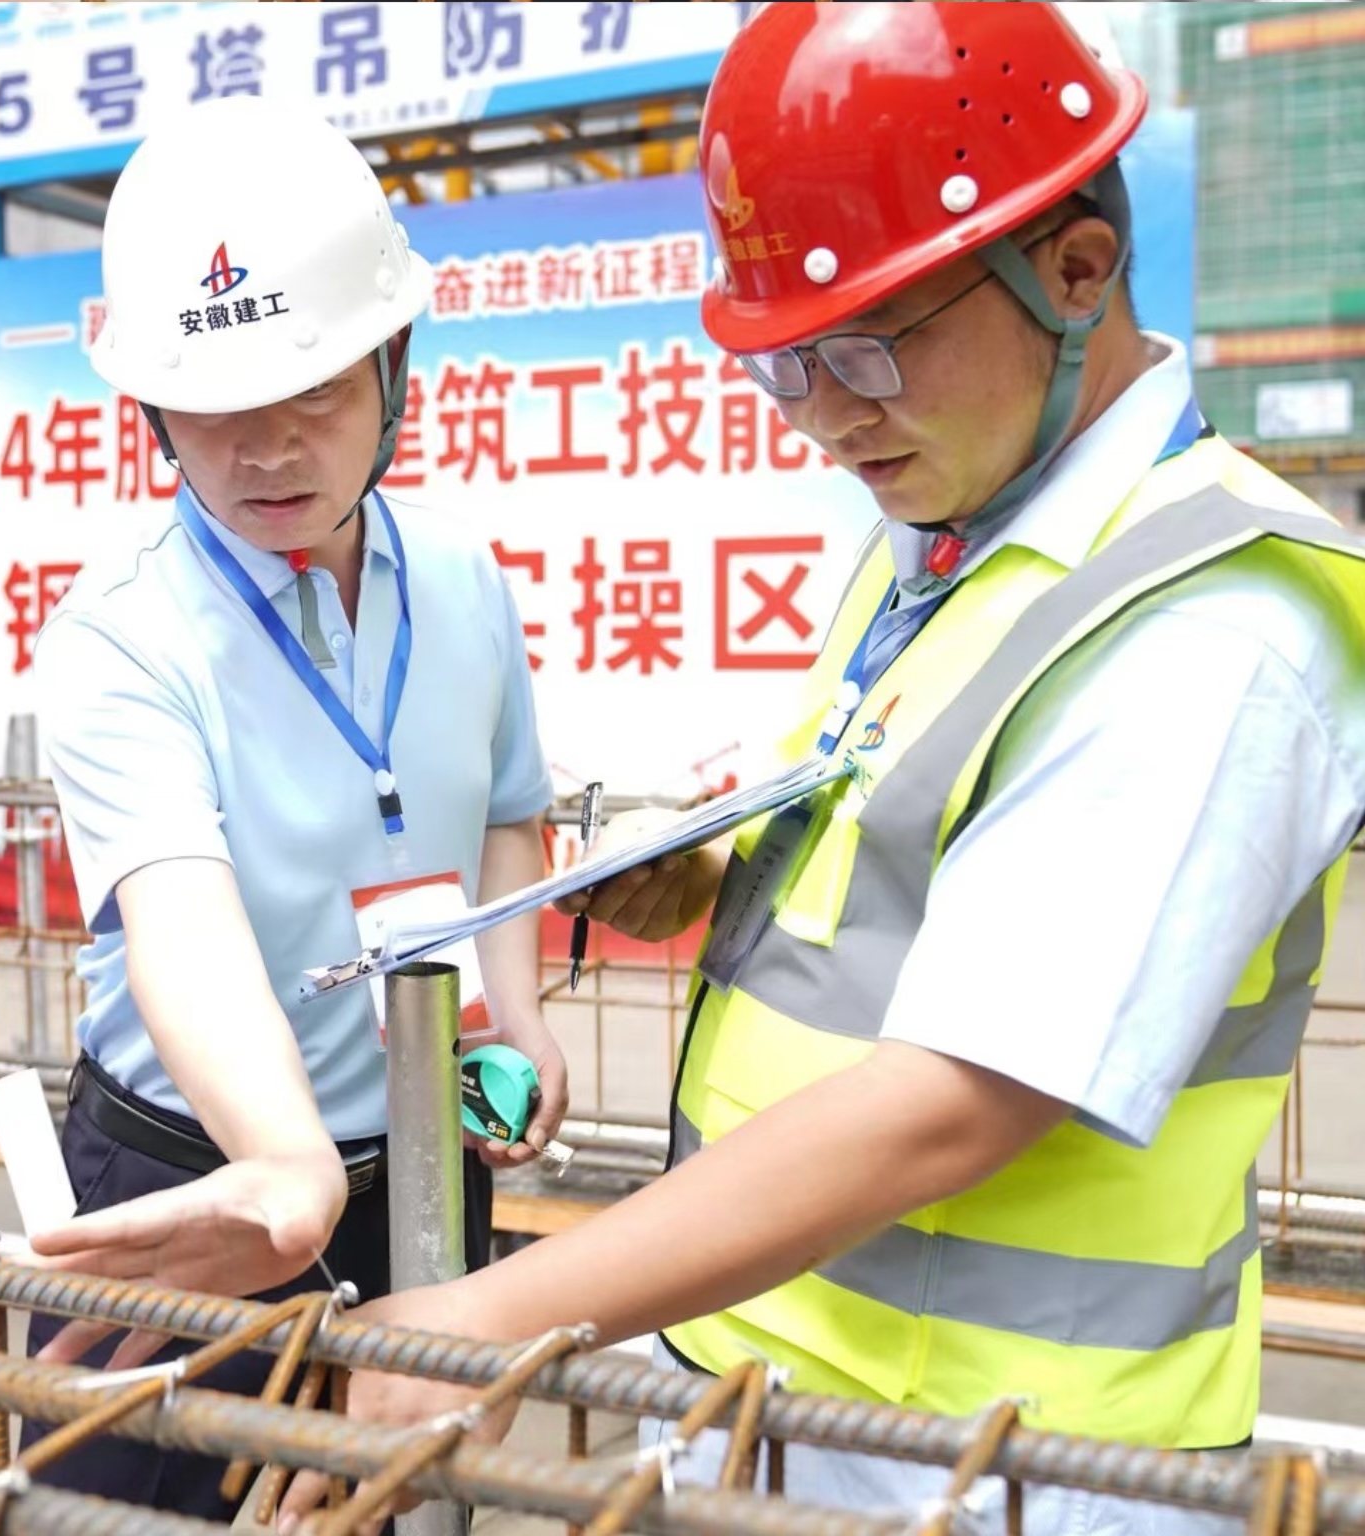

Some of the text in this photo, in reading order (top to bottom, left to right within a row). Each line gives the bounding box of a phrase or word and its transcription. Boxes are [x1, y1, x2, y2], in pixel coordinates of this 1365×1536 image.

[434, 240, 700, 314] 奋进新征程
[179, 292, 290, 336] 安徽建工
[487, 1121, 509, 1139] 5m
